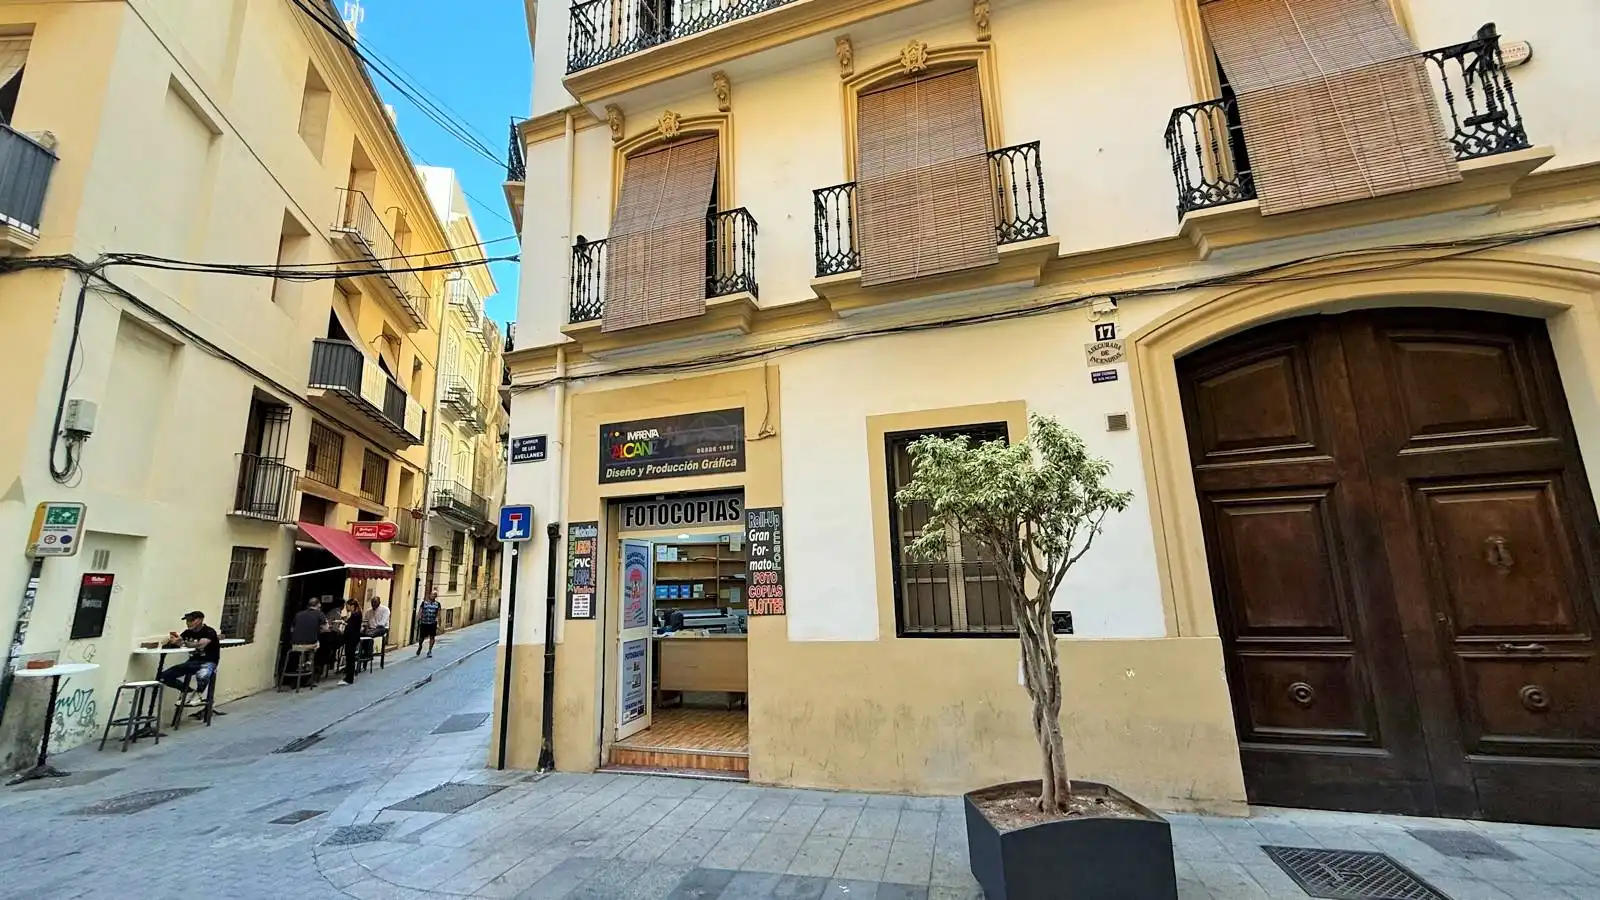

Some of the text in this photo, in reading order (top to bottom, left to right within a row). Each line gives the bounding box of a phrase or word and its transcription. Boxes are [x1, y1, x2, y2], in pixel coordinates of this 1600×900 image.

[1098, 325, 1113, 339] 17
[627, 429, 660, 440] IMPRENTA
[514, 452, 543, 460] AVELLANES
[606, 457, 737, 478] Diseño y Producción Gráfica
[625, 498, 740, 527] FOTOCOPIAS
[749, 529, 770, 541] Gran
[752, 544, 769, 556] For-
[575, 558, 591, 568] PVC
[750, 559, 772, 570] mato
[748, 585, 783, 598] COPIAS
[748, 599, 784, 614] PLOTTER
